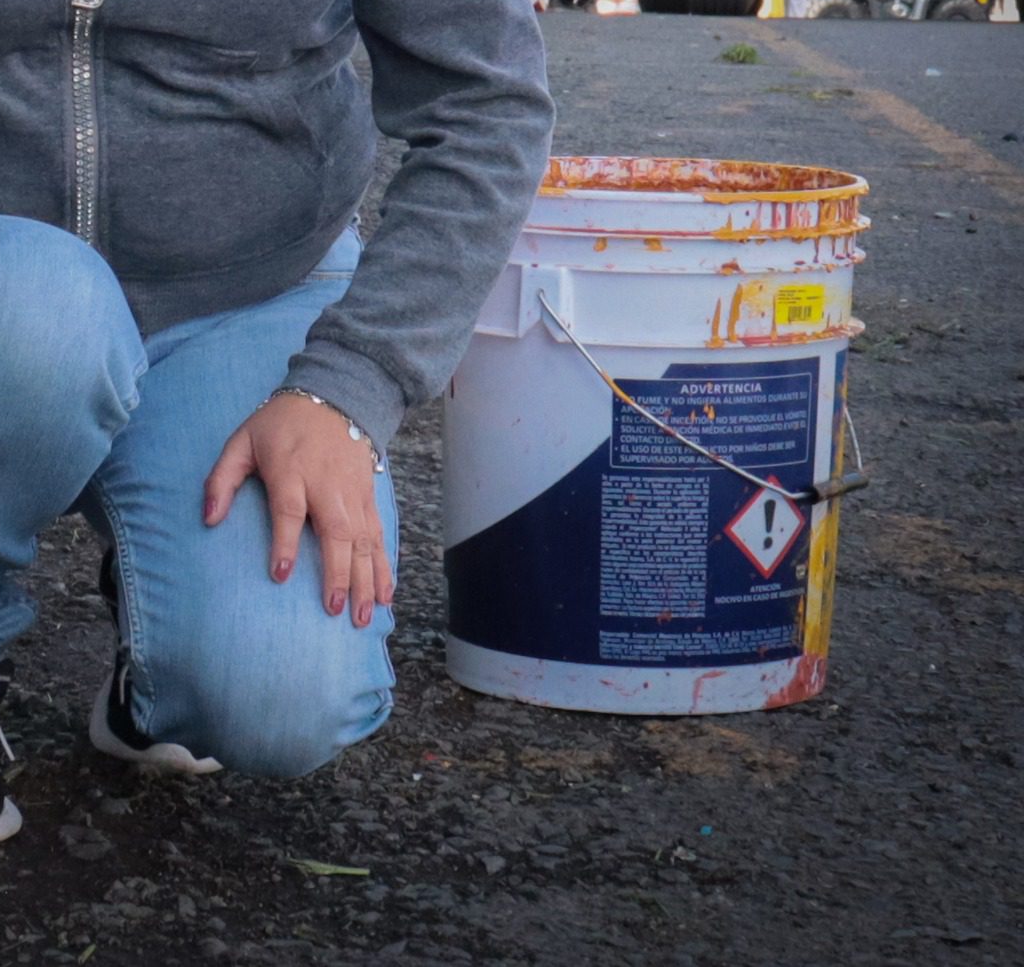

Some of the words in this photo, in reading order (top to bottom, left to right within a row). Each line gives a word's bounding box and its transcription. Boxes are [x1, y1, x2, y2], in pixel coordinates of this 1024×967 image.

[680, 382, 762, 394] ADVERTENCIA
[637, 396, 663, 405] FUME
[664, 396, 671, 405] Y
[671, 396, 685, 405] NO
[723, 394, 767, 405] ALIMENTOS
[621, 415, 633, 424] EN
[634, 415, 656, 424] CAS
[716, 415, 728, 424] NO
[619, 434, 664, 444] CONTACTO
[621, 445, 632, 453] EL
[632, 445, 649, 453] USO
[651, 445, 662, 454] DE
[663, 445, 682, 454] ESTE
[729, 444, 744, 453] POR
[619, 454, 677, 464] SUPERVISADO
[679, 455, 695, 464] POR
